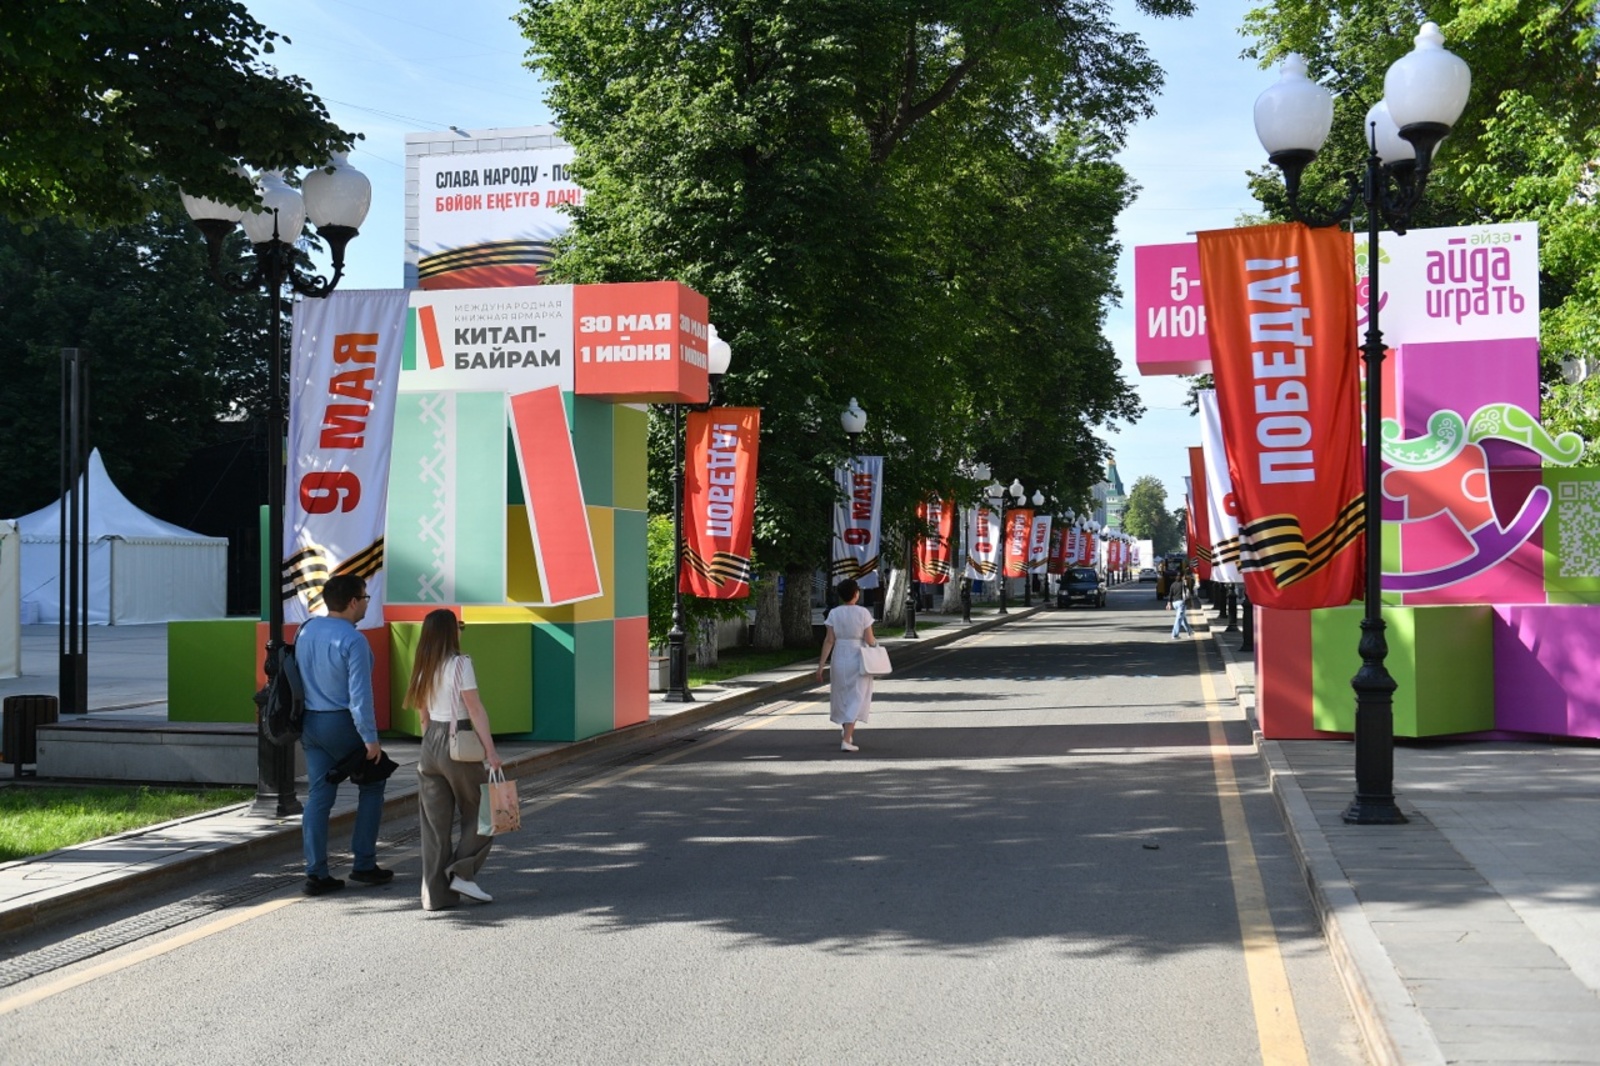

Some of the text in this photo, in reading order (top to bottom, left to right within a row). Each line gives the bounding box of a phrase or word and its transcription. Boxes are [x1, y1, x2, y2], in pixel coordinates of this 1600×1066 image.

[436, 169, 479, 189] СЛАВА
[483, 165, 539, 187] НАРОДУ
[435, 193, 482, 213] БӨЙӨК
[545, 188, 582, 209] ДАН!
[454, 300, 562, 312] МЕЖДУНАРОДНАЯ
[454, 310, 562, 322] КНИЖНАЯ ЯРМАРКА
[1426, 286, 1525, 325] играть
[580, 313, 672, 333] 30 МАЯ
[454, 325, 547, 346] КИТАП-
[454, 346, 561, 370] БАЙРАМ
[580, 343, 671, 363] 1 ИЮНЯ
[1245, 255, 1316, 485] ПОБЕДА!
[299, 332, 379, 515] 9 МАЯ
[844, 473, 873, 546] 9 МАЯ
